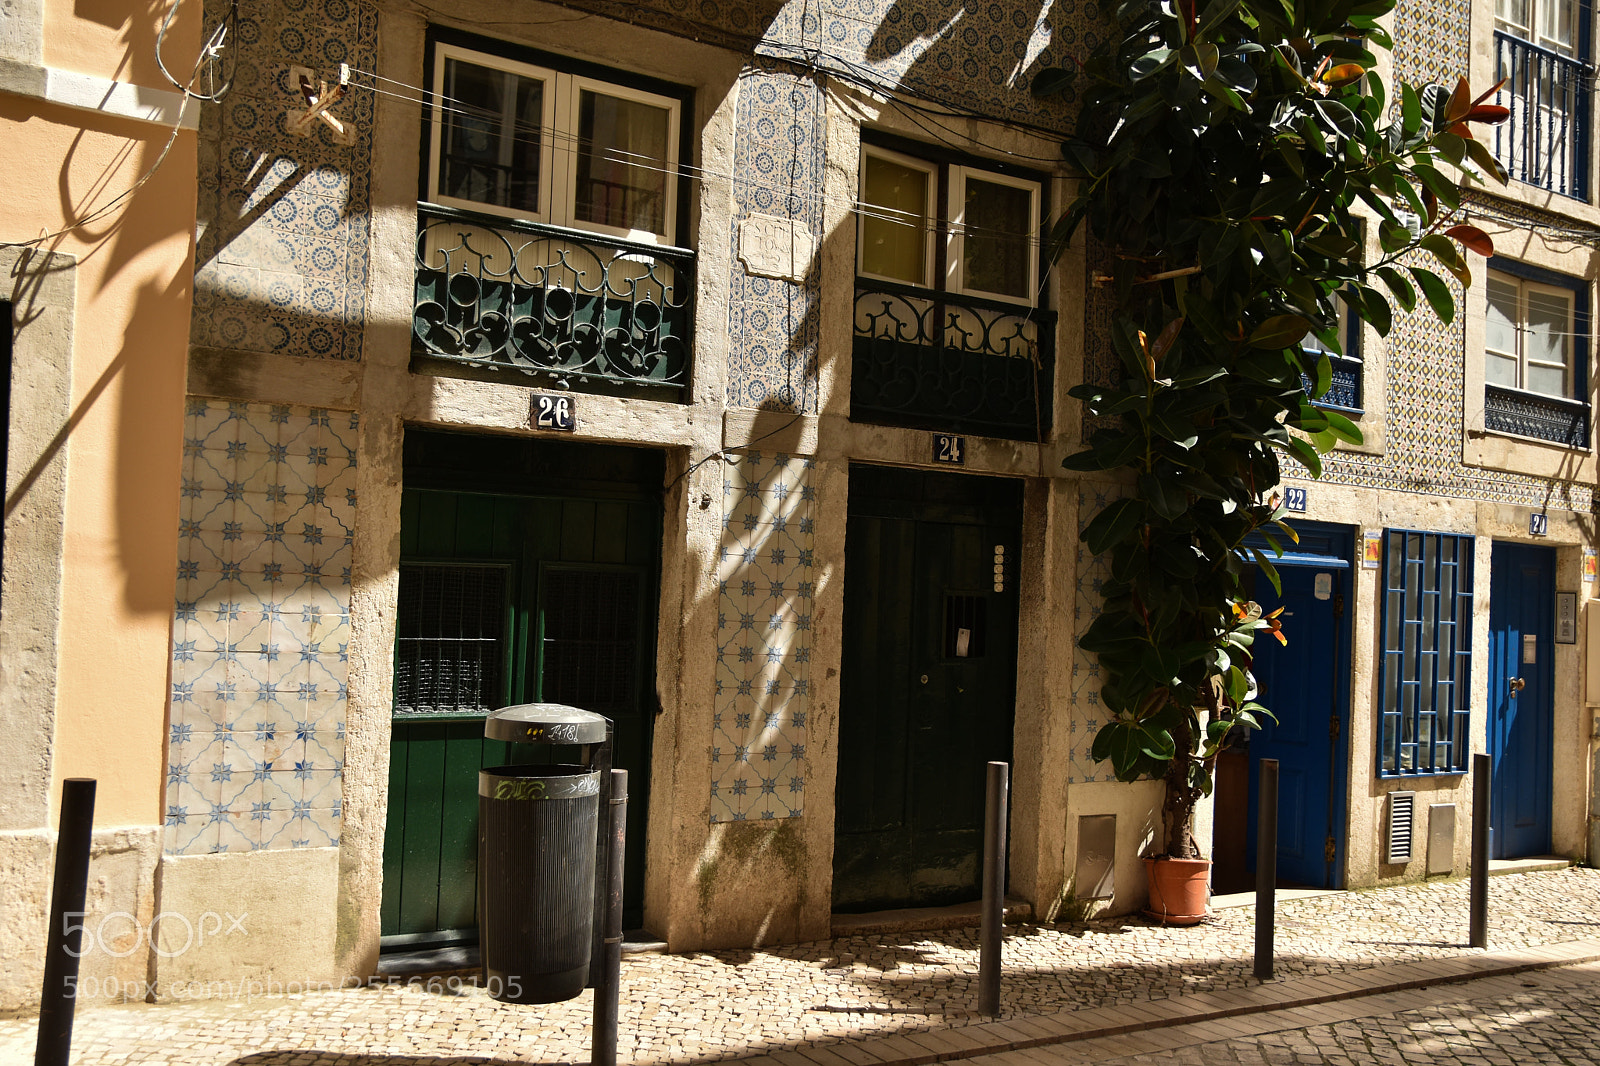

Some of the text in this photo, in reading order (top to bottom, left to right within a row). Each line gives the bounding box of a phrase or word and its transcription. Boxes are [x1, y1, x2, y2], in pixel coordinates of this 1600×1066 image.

[538, 396, 569, 428] 26
[939, 437, 960, 461] 24
[1288, 489, 1304, 510] 22
[1533, 515, 1546, 533] 20
